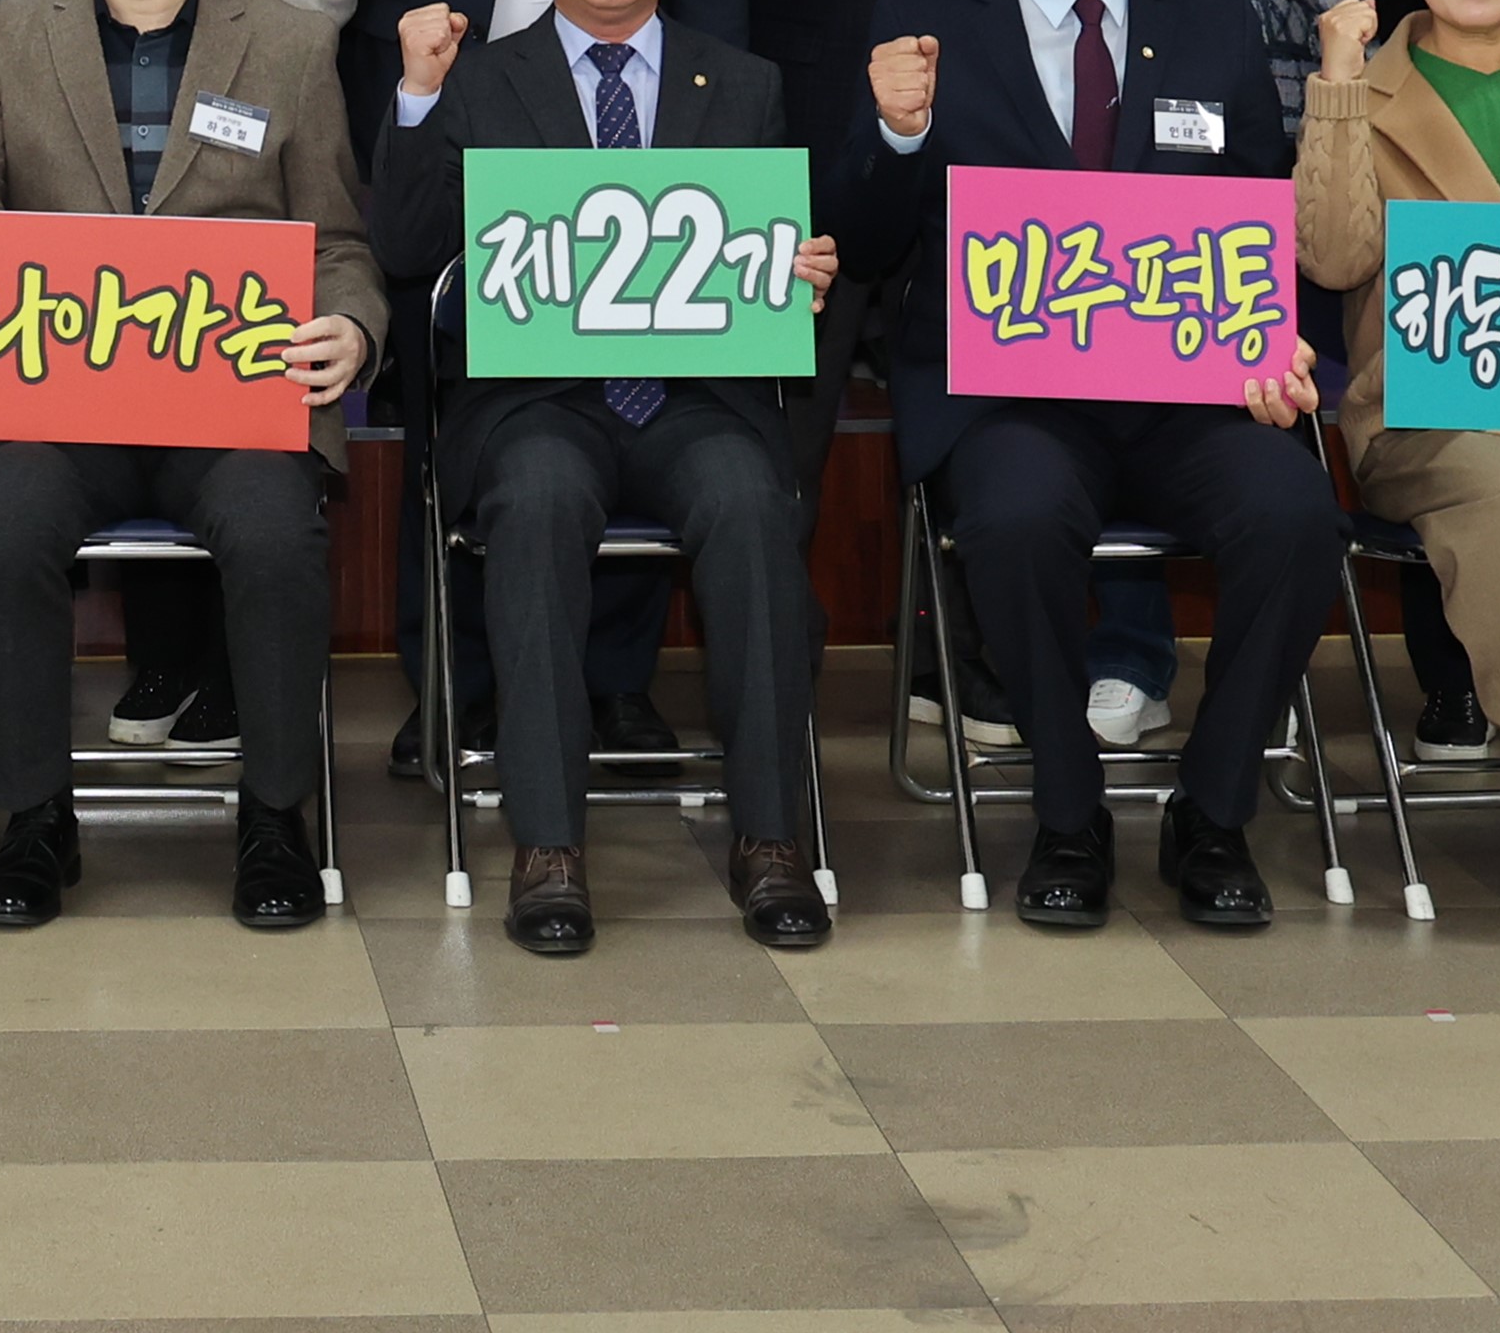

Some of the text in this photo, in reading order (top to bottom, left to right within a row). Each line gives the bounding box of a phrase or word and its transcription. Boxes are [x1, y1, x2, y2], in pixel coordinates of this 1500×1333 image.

[206, 119, 249, 142] 하승철
[478, 183, 801, 335] 제22기
[963, 218, 1286, 365] 민주평통
